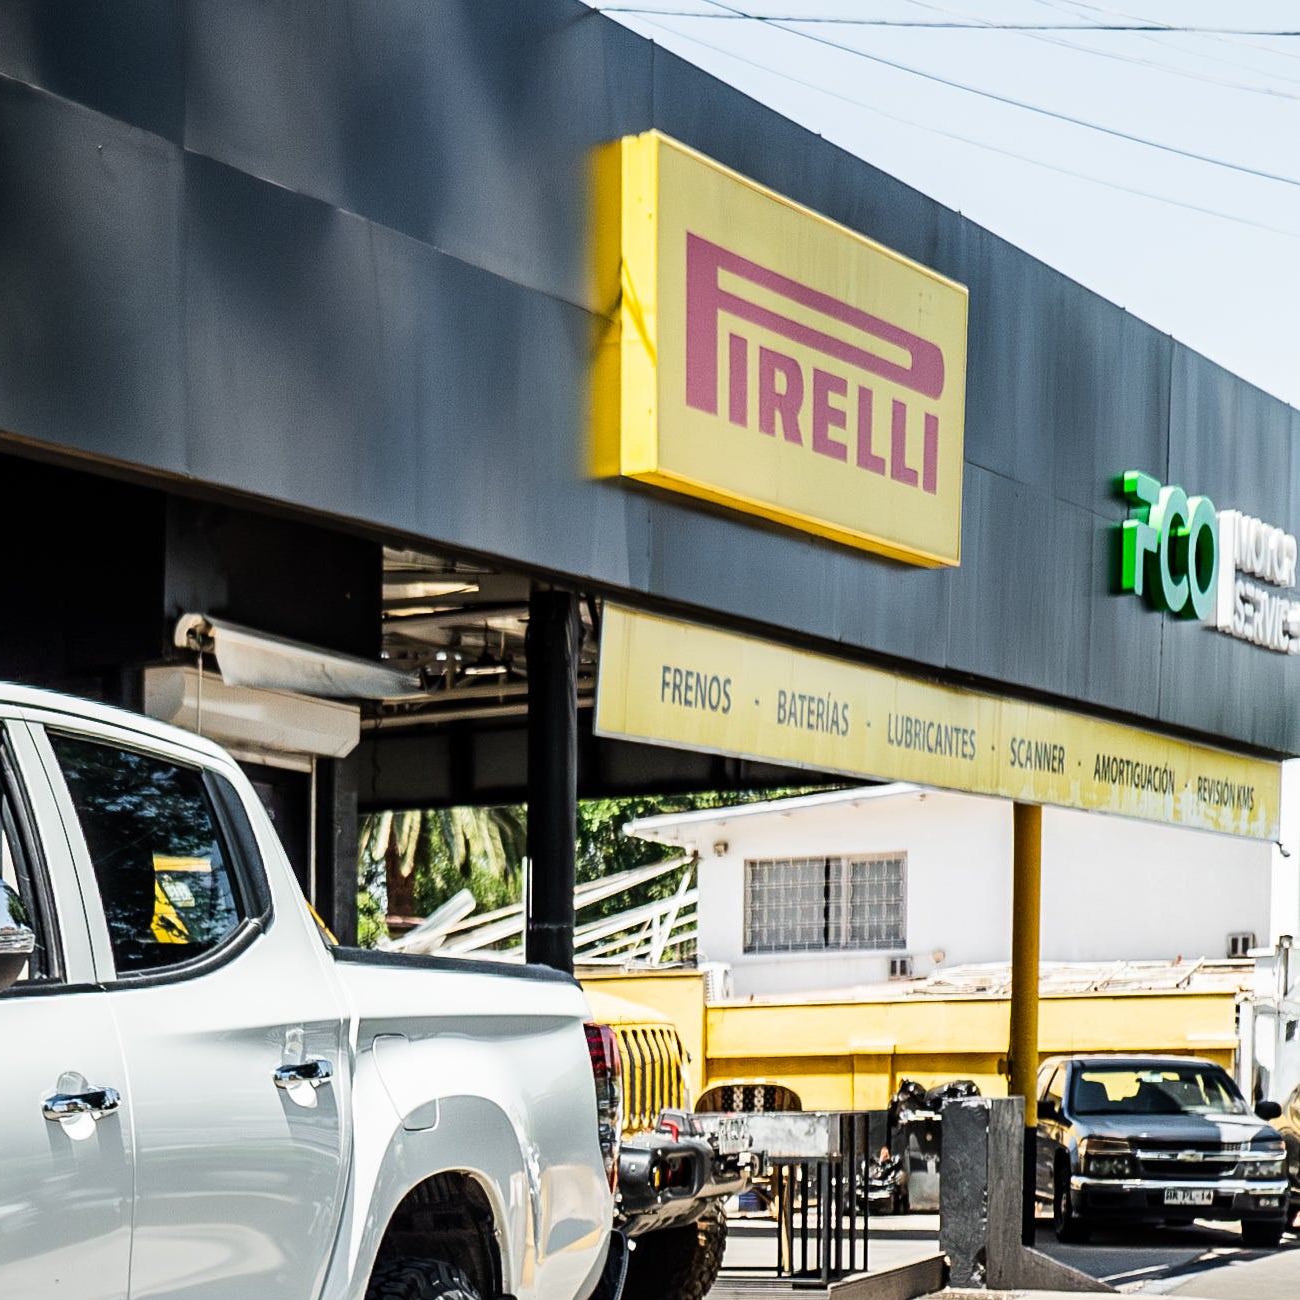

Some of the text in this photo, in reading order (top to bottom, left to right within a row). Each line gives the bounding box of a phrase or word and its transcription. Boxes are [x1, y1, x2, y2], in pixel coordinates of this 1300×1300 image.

[686, 229, 945, 496] PIRELLI
[661, 665, 1255, 812] FRENOS BATERÍAS LUBRICANTES SCANNER AMORTIGUACIÓN REVISIÓN KMS
